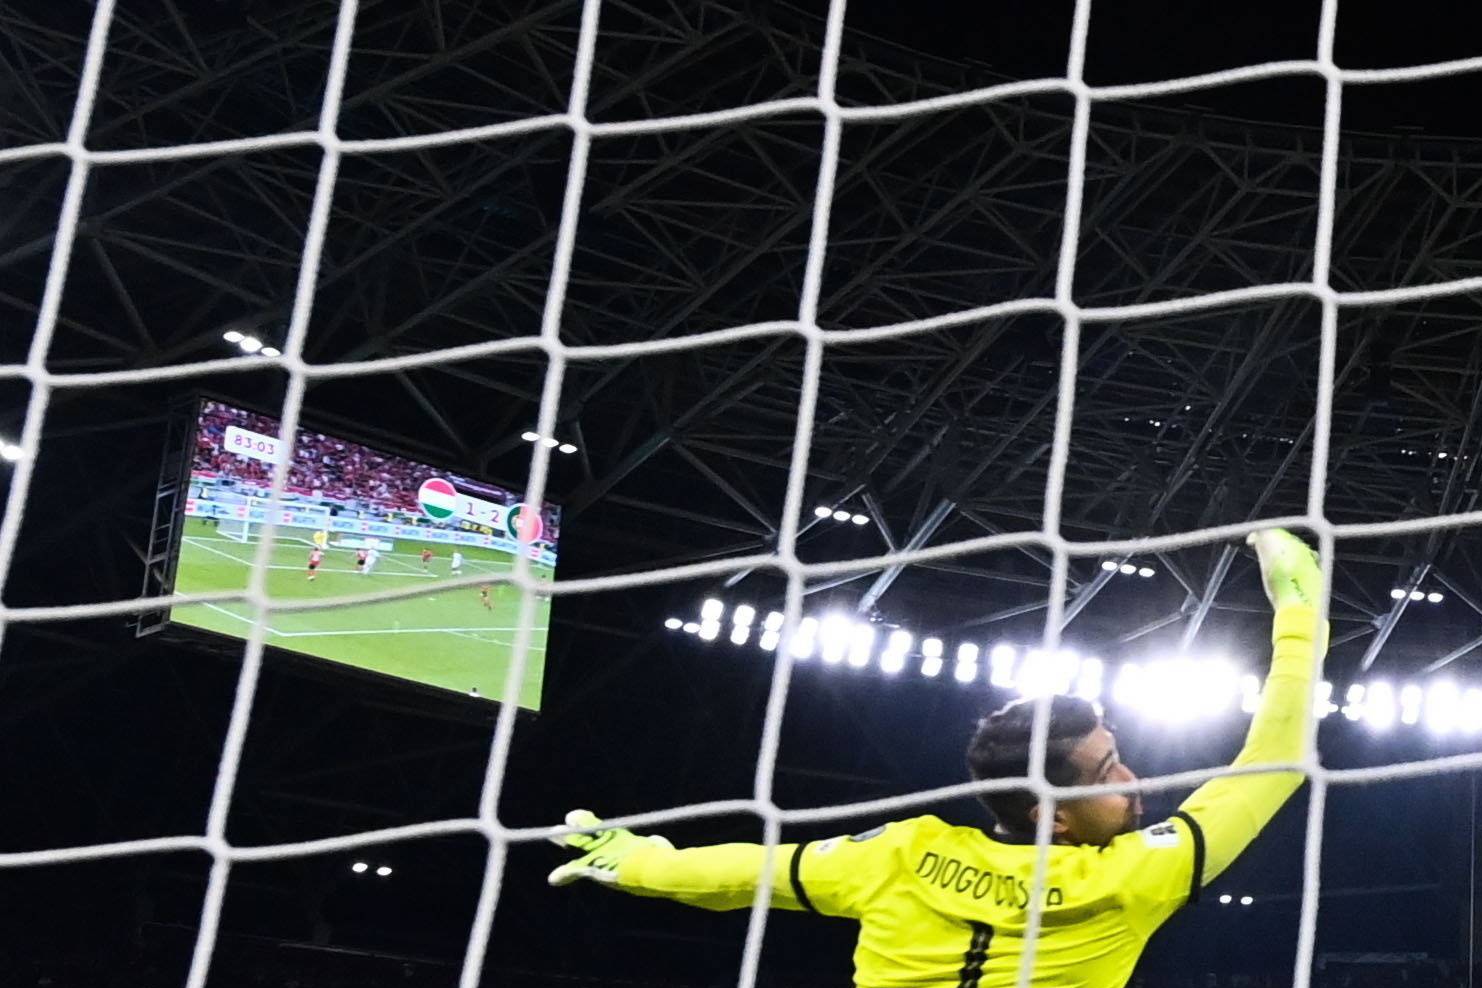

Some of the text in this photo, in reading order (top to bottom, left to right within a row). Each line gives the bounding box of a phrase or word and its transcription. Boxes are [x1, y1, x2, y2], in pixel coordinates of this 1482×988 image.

[234, 434, 274, 455] 83:03
[916, 851, 1064, 910] DIOGO COSA
